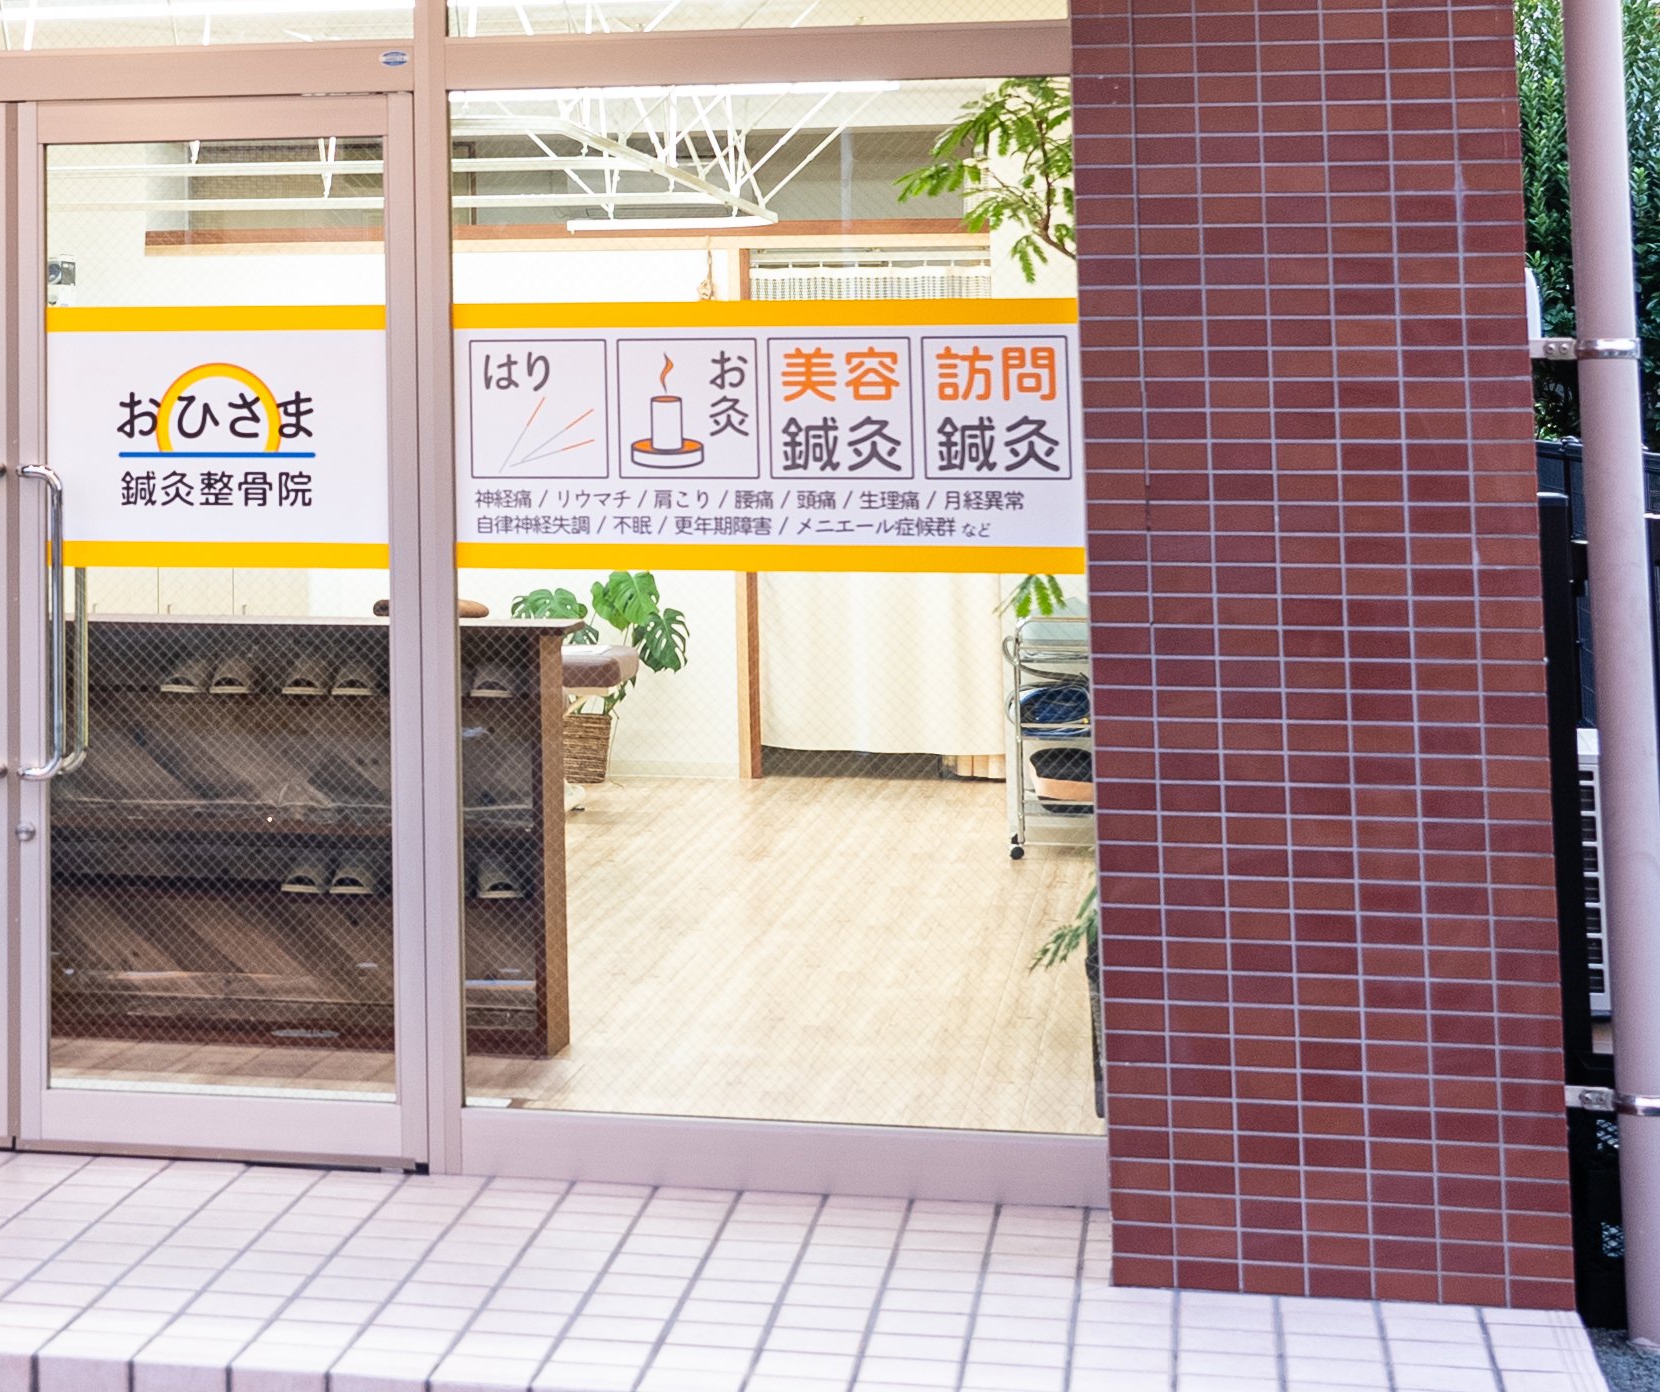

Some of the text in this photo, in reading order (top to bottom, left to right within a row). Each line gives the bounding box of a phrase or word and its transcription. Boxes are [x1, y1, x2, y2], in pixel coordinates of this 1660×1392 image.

[483, 351, 551, 392] はり
[709, 350, 750, 437] お灸
[781, 346, 900, 402] 美容
[937, 346, 1057, 401] 訪問
[117, 391, 314, 438] おひさま
[781, 416, 902, 472] 鍼灸
[937, 416, 1060, 472] 鍼灸
[121, 470, 312, 507] 鍼灸整骨院
[475, 489, 1025, 511] 神経痛 リウマチ 肩こり 腰痛 頭痛 生理痛 月経異常
[477, 515, 590, 535] 自律神経失調
[613, 516, 652, 535] 不眠
[675, 516, 771, 536] 更年期障害
[961, 522, 991, 538] など
